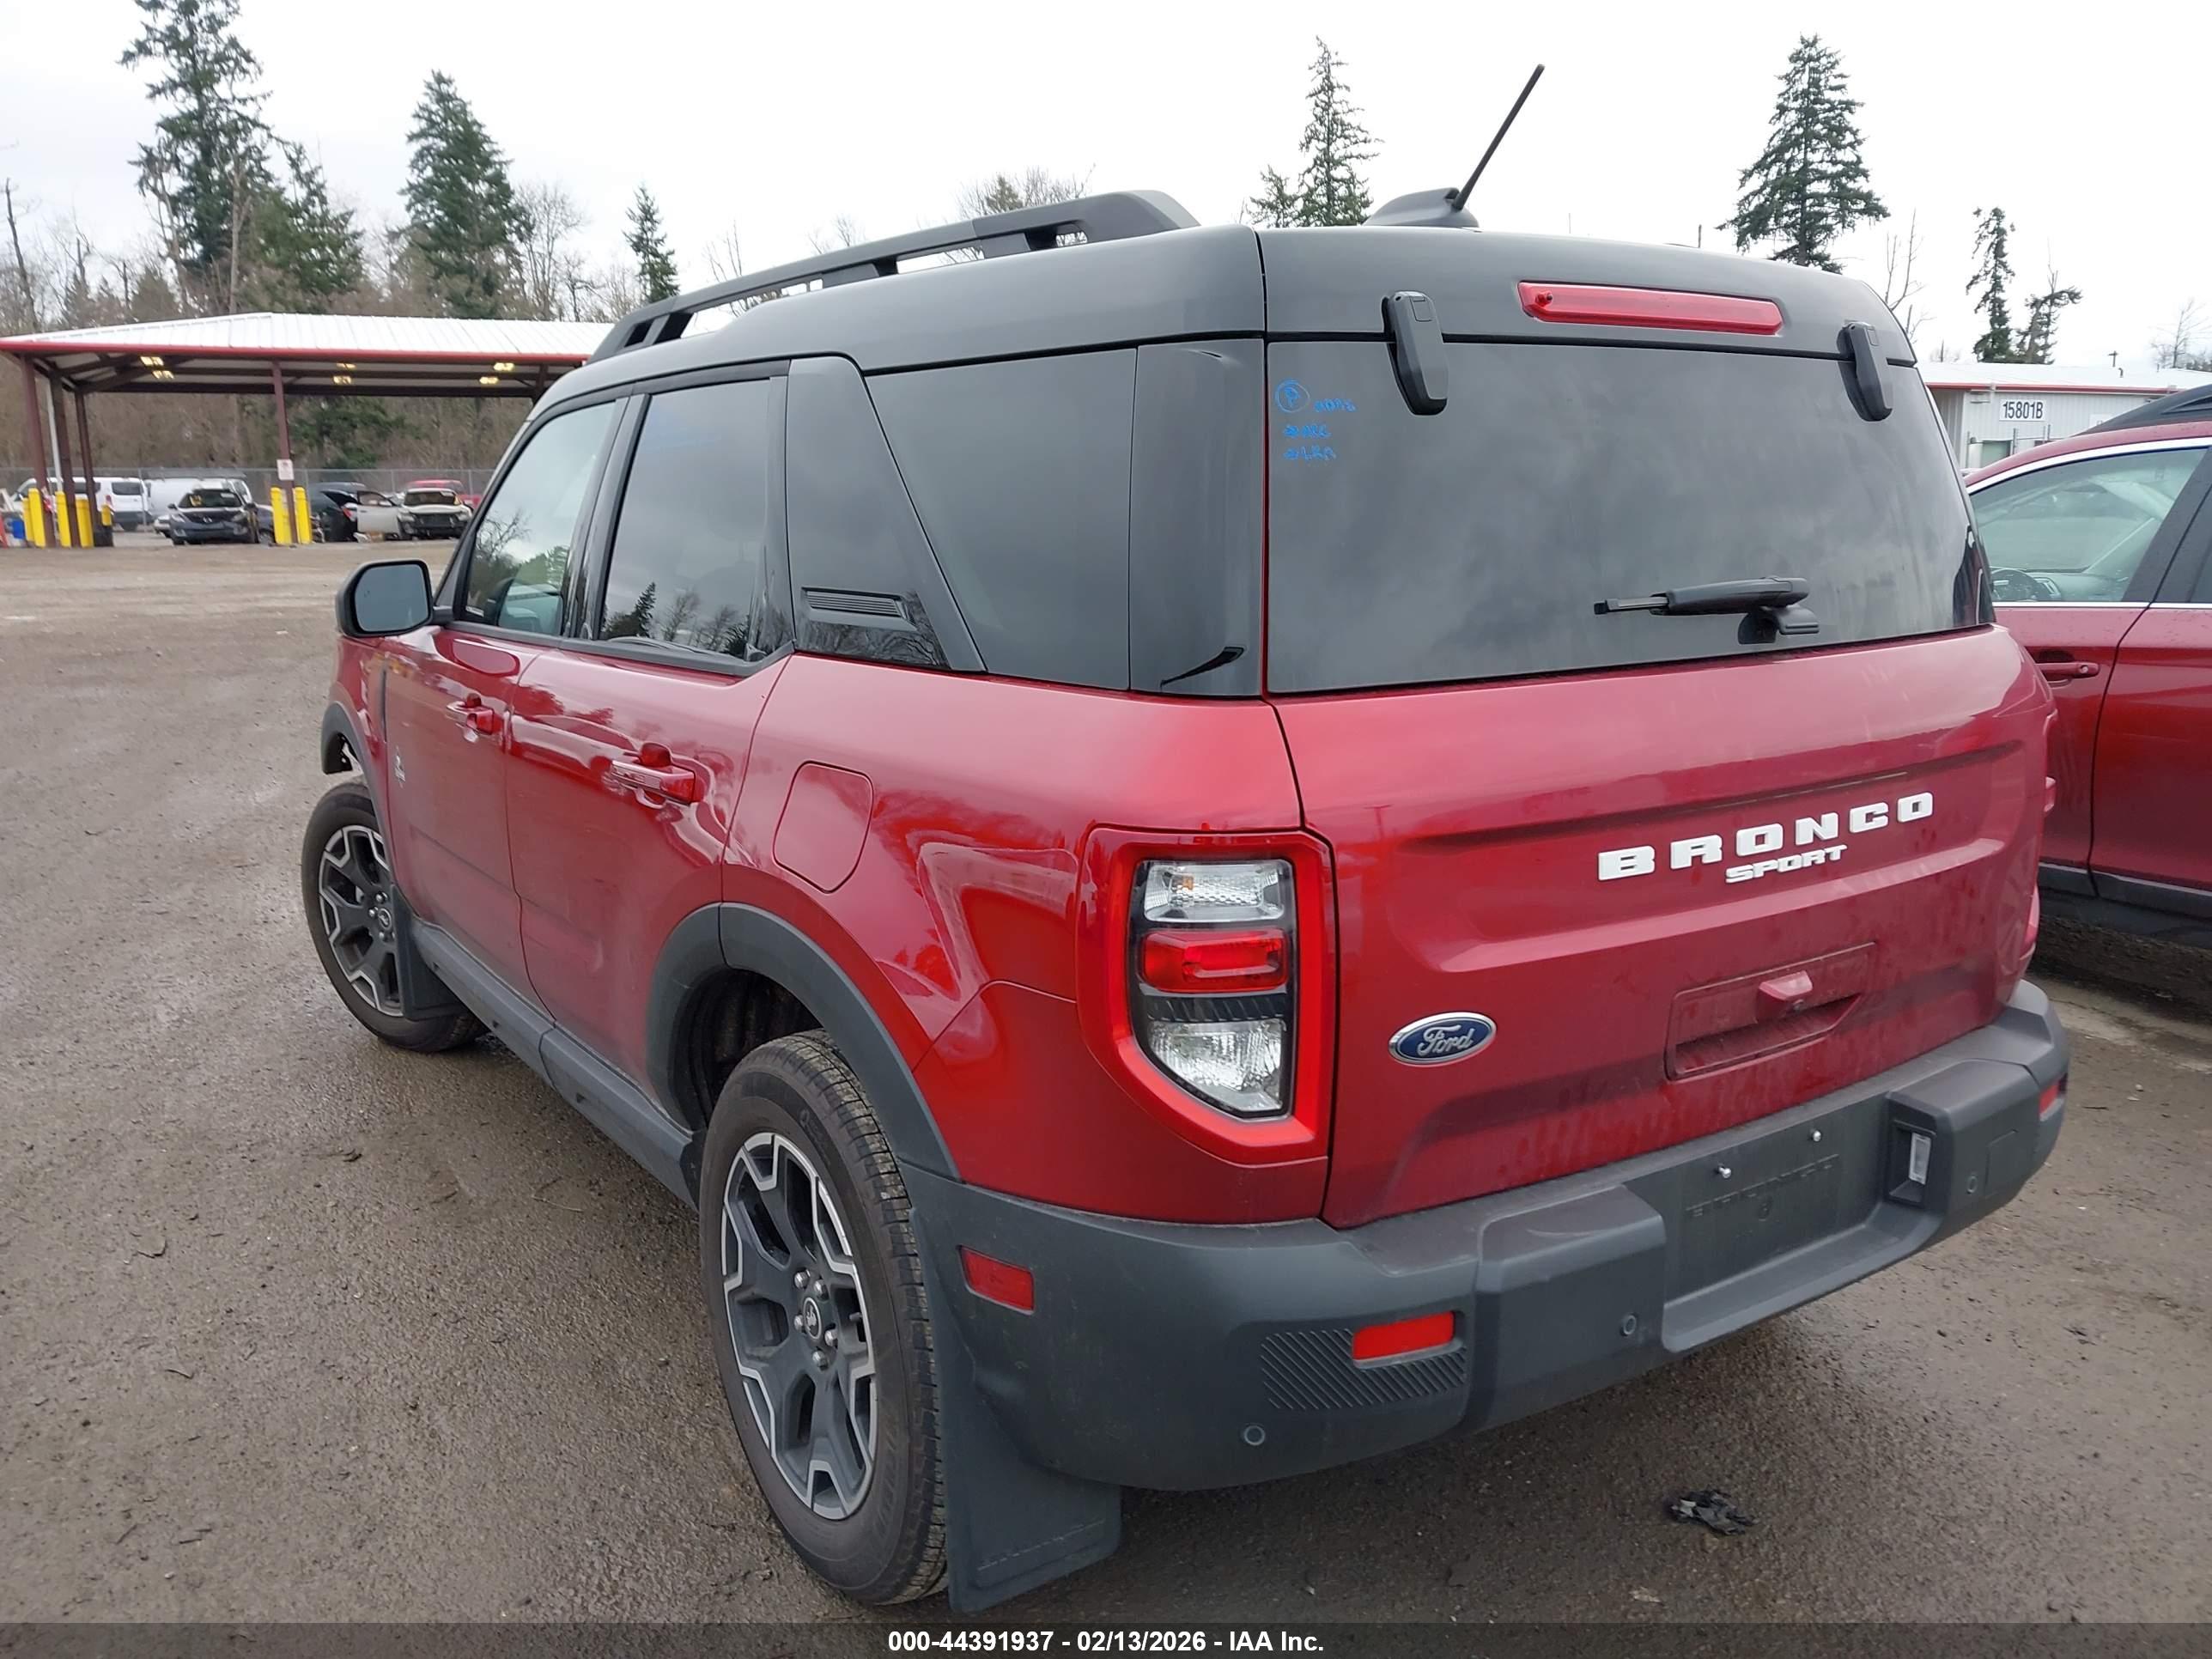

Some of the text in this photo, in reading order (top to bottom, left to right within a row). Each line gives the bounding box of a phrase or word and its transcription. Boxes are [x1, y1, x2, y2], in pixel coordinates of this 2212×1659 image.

[2002, 401, 2044, 419] 15801B
[1598, 792, 1933, 881] BRONCO
[1725, 844, 1848, 884] SPORT
[1417, 1024, 1474, 1056] Ford
